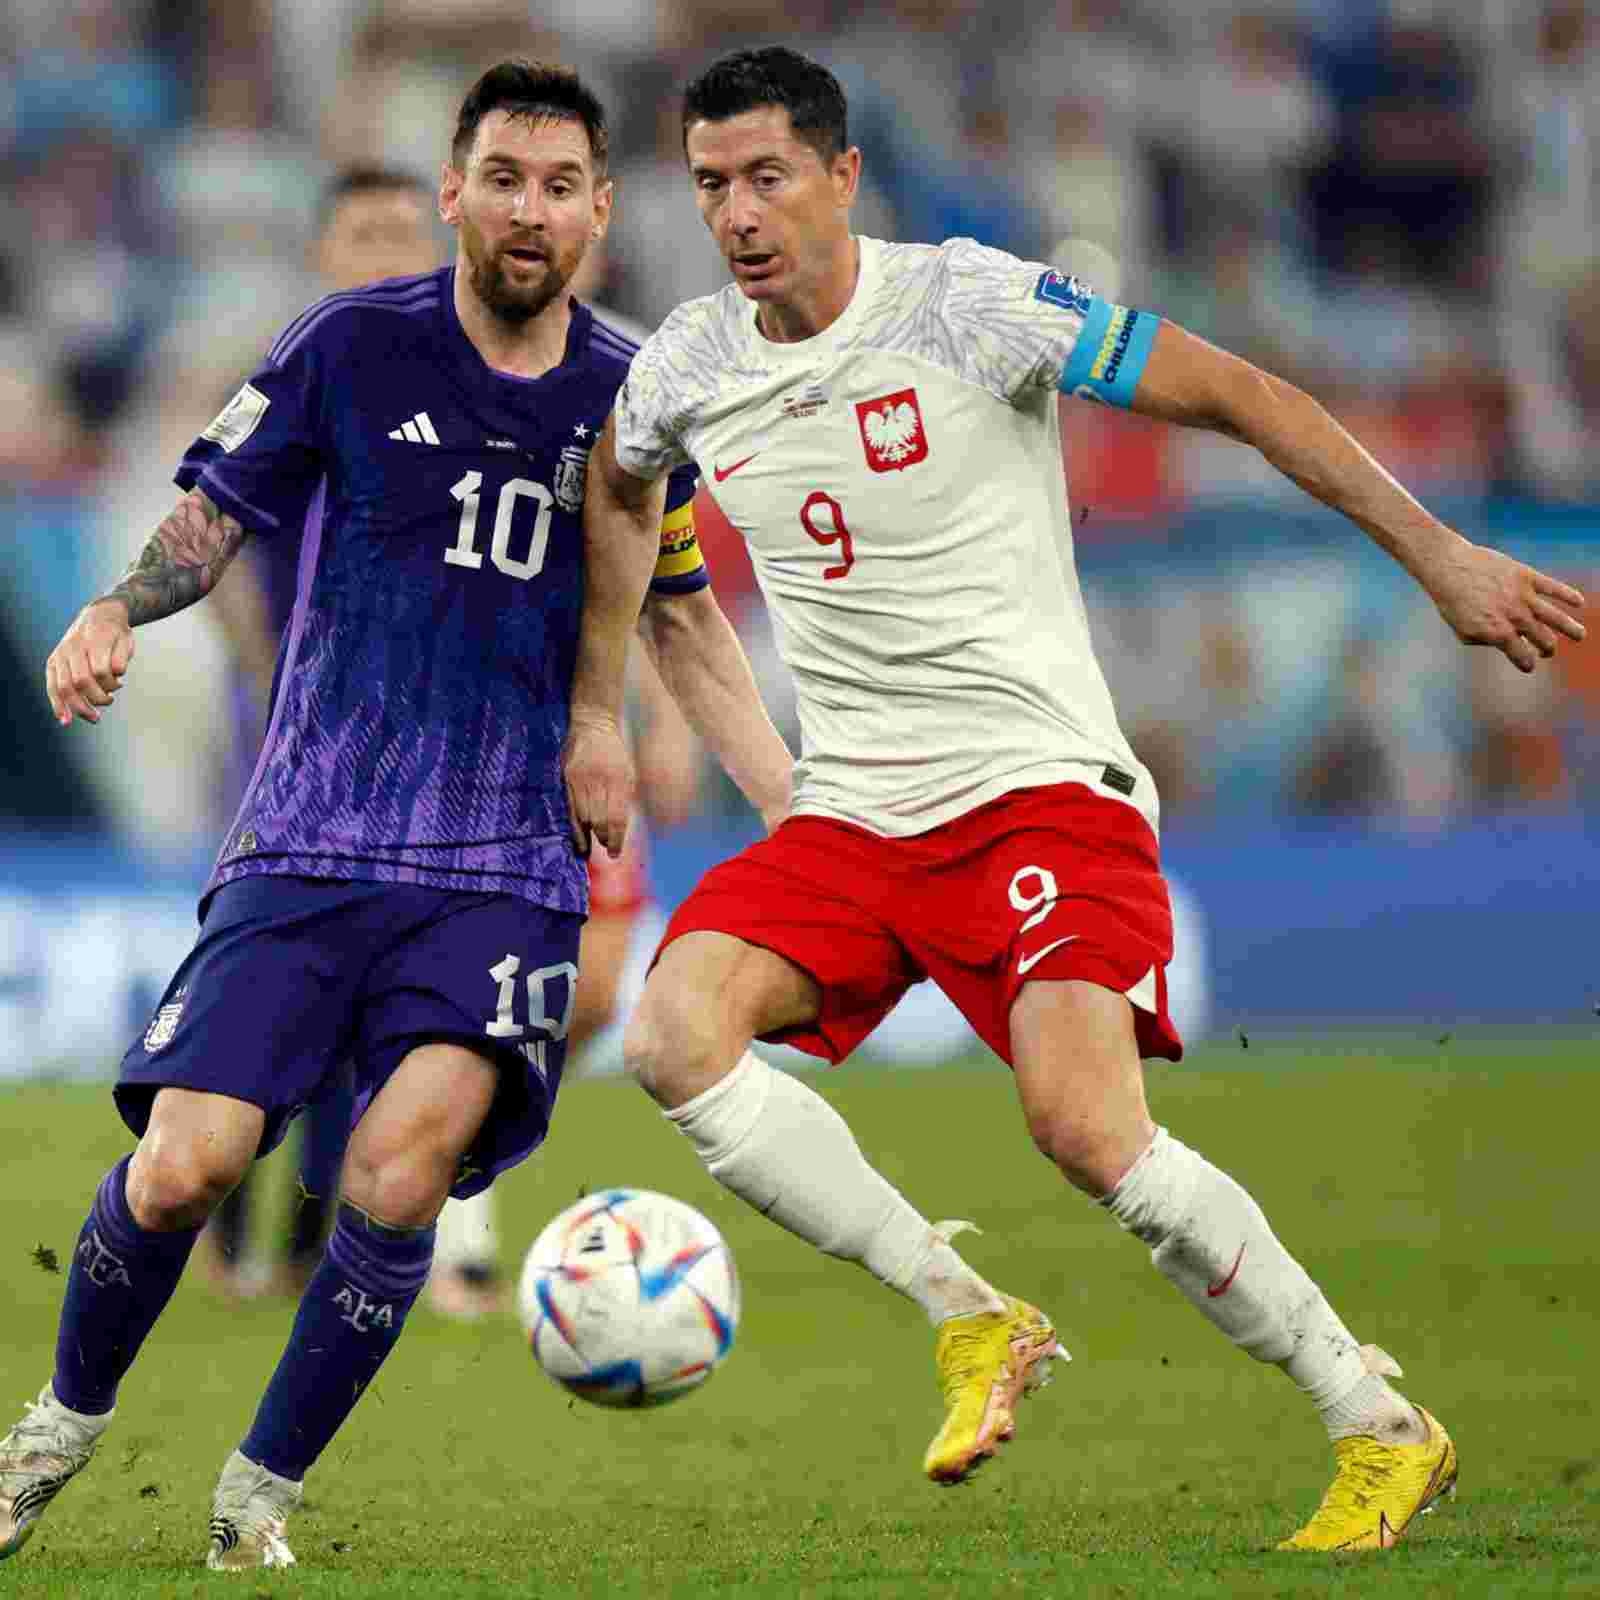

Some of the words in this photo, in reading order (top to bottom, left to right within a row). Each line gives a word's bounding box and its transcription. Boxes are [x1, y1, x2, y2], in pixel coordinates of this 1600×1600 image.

[444, 470, 554, 580] 10
[800, 491, 854, 580] 9
[1008, 865, 1057, 934] 9
[486, 953, 577, 1041] 10
